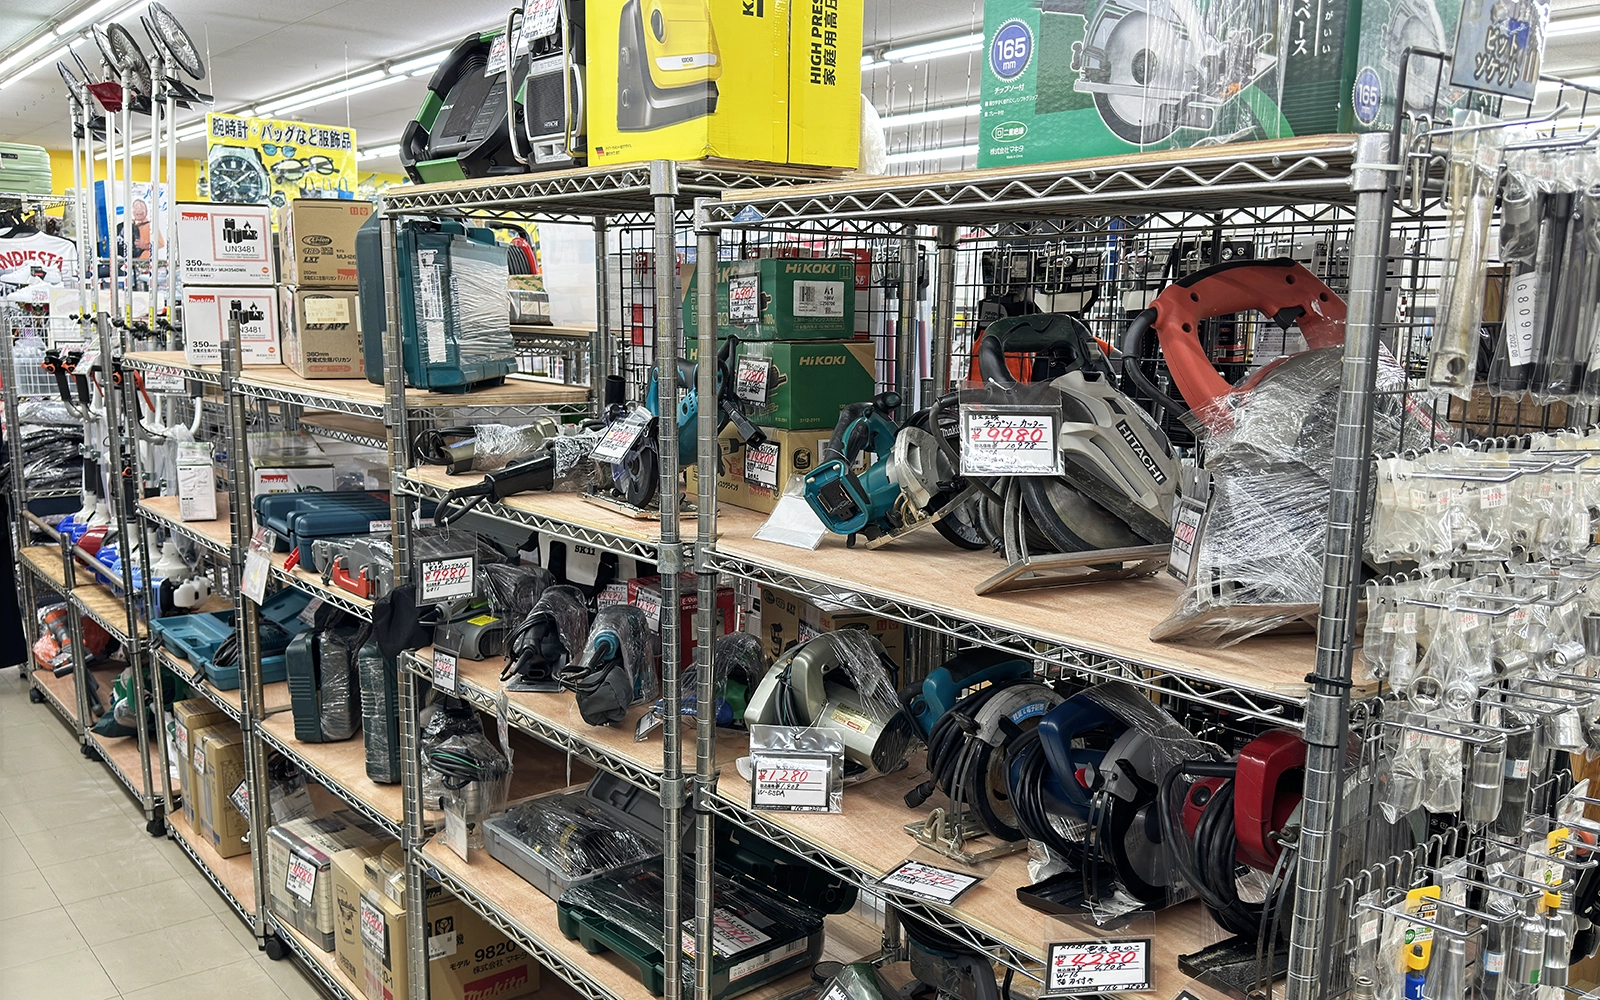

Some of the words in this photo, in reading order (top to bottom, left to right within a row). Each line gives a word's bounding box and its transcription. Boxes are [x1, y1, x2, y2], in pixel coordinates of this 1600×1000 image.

[743, 0, 754, 16] K
[1292, 0, 1311, 56] ベース
[1322, 0, 1334, 54] がいい
[998, 37, 1026, 60] 165
[811, 42, 822, 84] HIGH
[1003, 60, 1016, 70] mm
[1475, 53, 1519, 87] ソケット
[994, 83, 1025, 94] チップソー付
[1359, 84, 1377, 106] 165
[212, 117, 352, 151] 腕時計・バッグなど服飾品
[225, 245, 255, 253] UN3481
[785, 263, 836, 274] HiKOKI
[824, 287, 834, 295] A1
[799, 356, 846, 366] HiKOKI
[1119, 424, 1164, 482] HITACHI
[574, 545, 595, 556] SK11
[475, 940, 517, 962] 9820
[450, 960, 470, 970] モデル
[473, 960, 503, 974] 株式会社
[506, 952, 528, 964] マキタ
